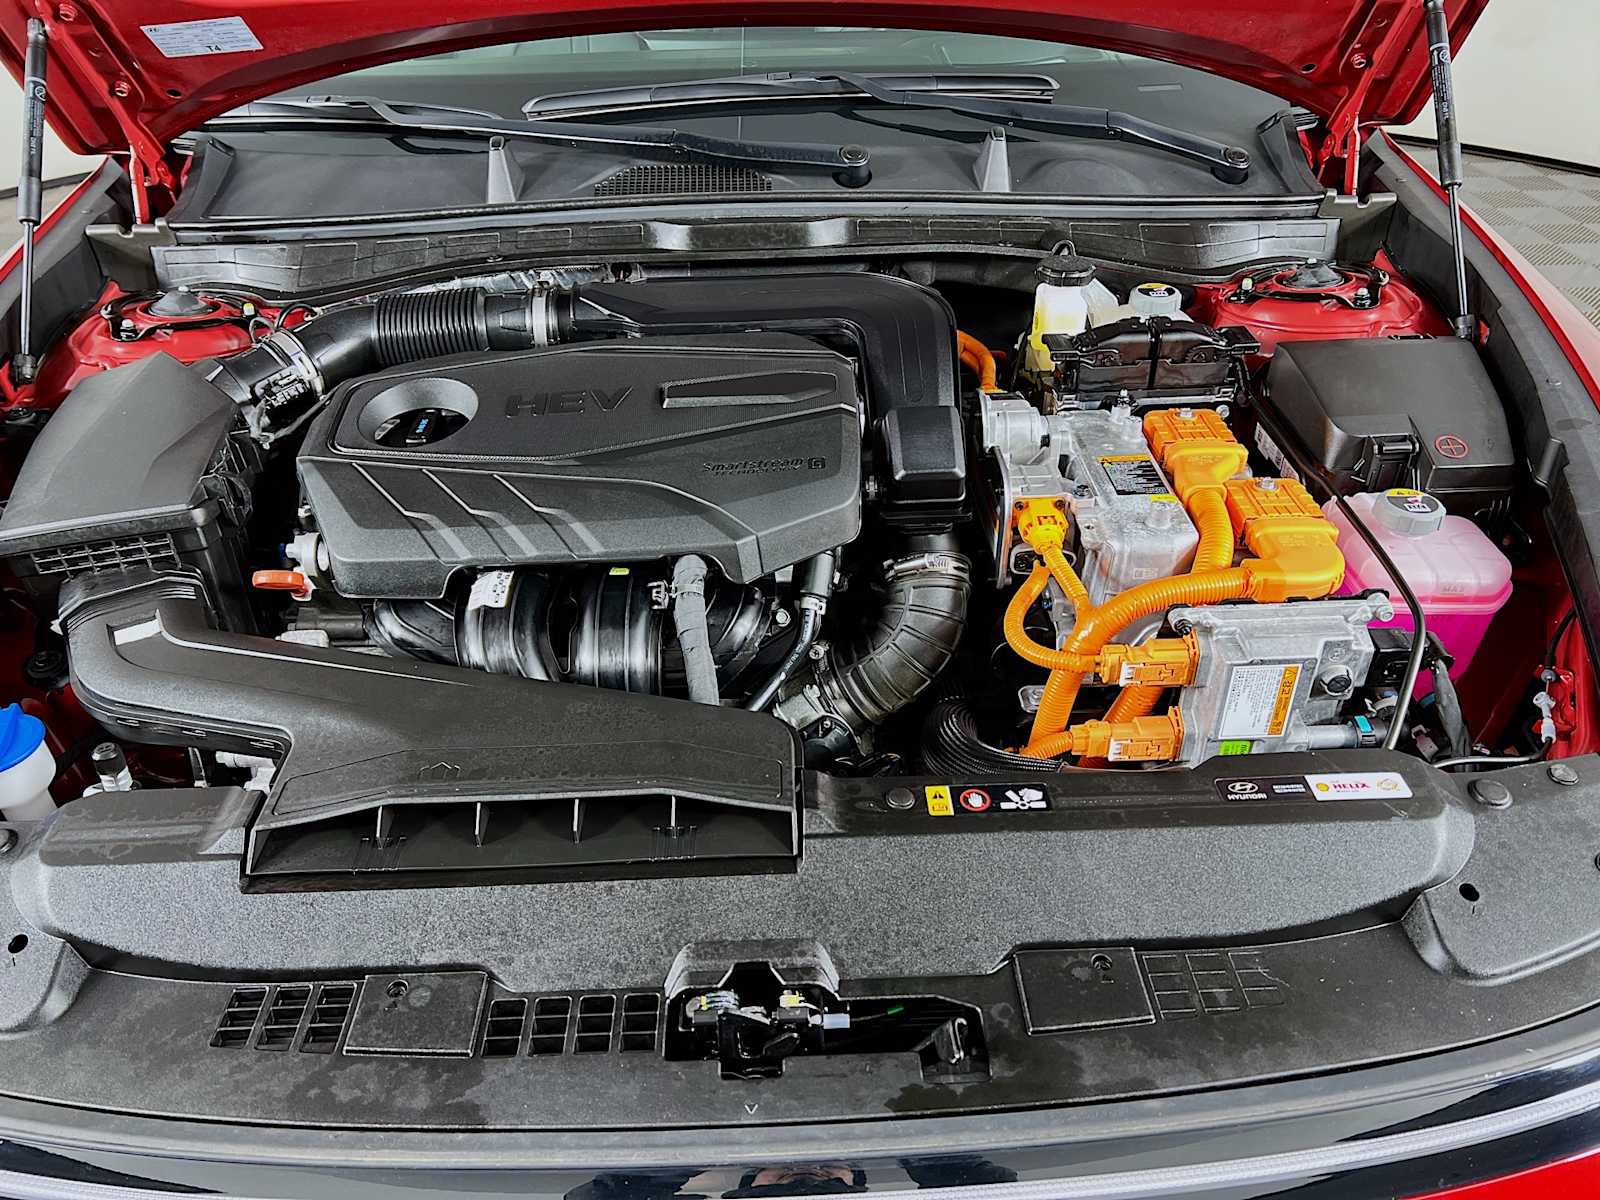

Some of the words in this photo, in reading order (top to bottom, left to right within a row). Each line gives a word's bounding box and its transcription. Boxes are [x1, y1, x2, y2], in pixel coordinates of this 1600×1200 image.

[504, 385, 633, 418] HEV
[702, 458, 804, 473] Smartstream
[1332, 782, 1371, 790] HELIX
